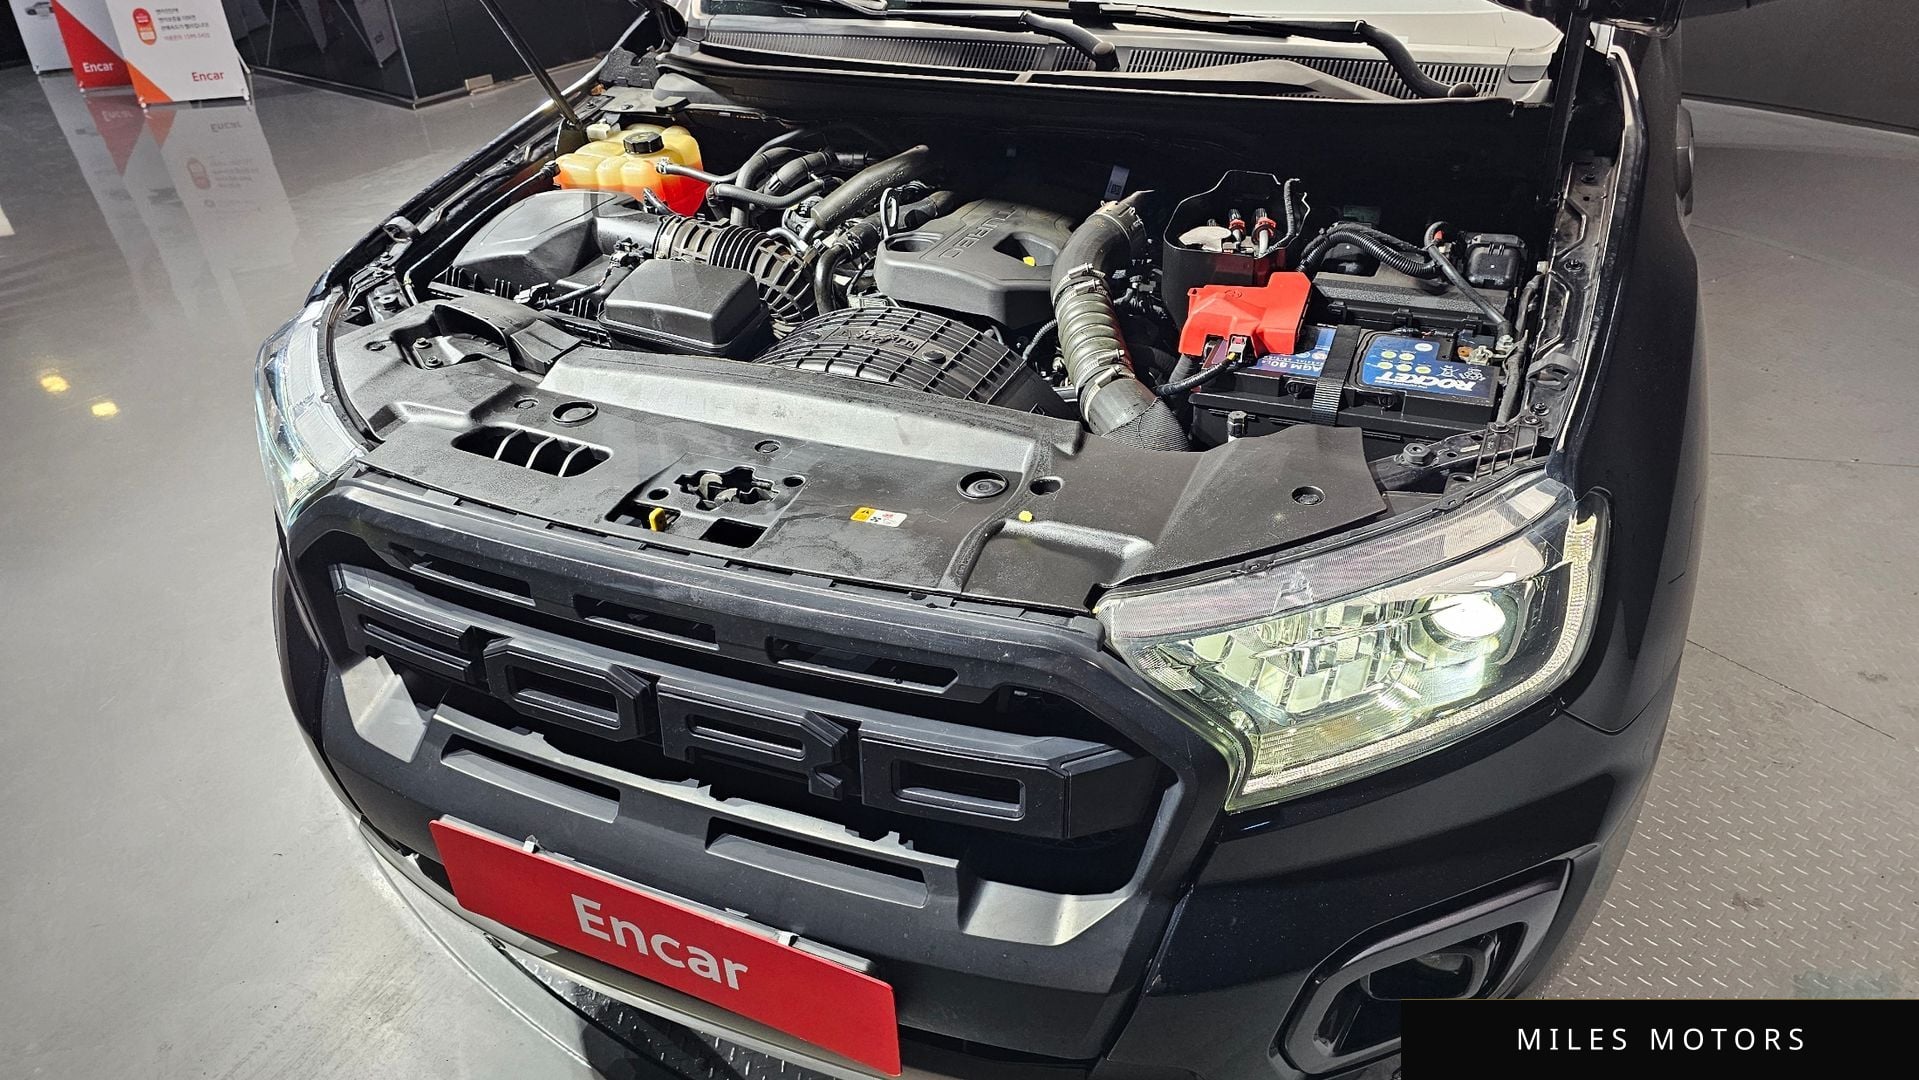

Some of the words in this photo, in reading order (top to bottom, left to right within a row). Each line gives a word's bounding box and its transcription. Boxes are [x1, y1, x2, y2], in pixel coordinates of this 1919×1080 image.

[83, 61, 115, 73] Encar
[191, 71, 225, 82] Encar
[1290, 363, 1323, 372] AGM
[1374, 371, 1477, 392] ROCKET
[336, 588, 1072, 840] FORD
[571, 893, 748, 991] Encar
